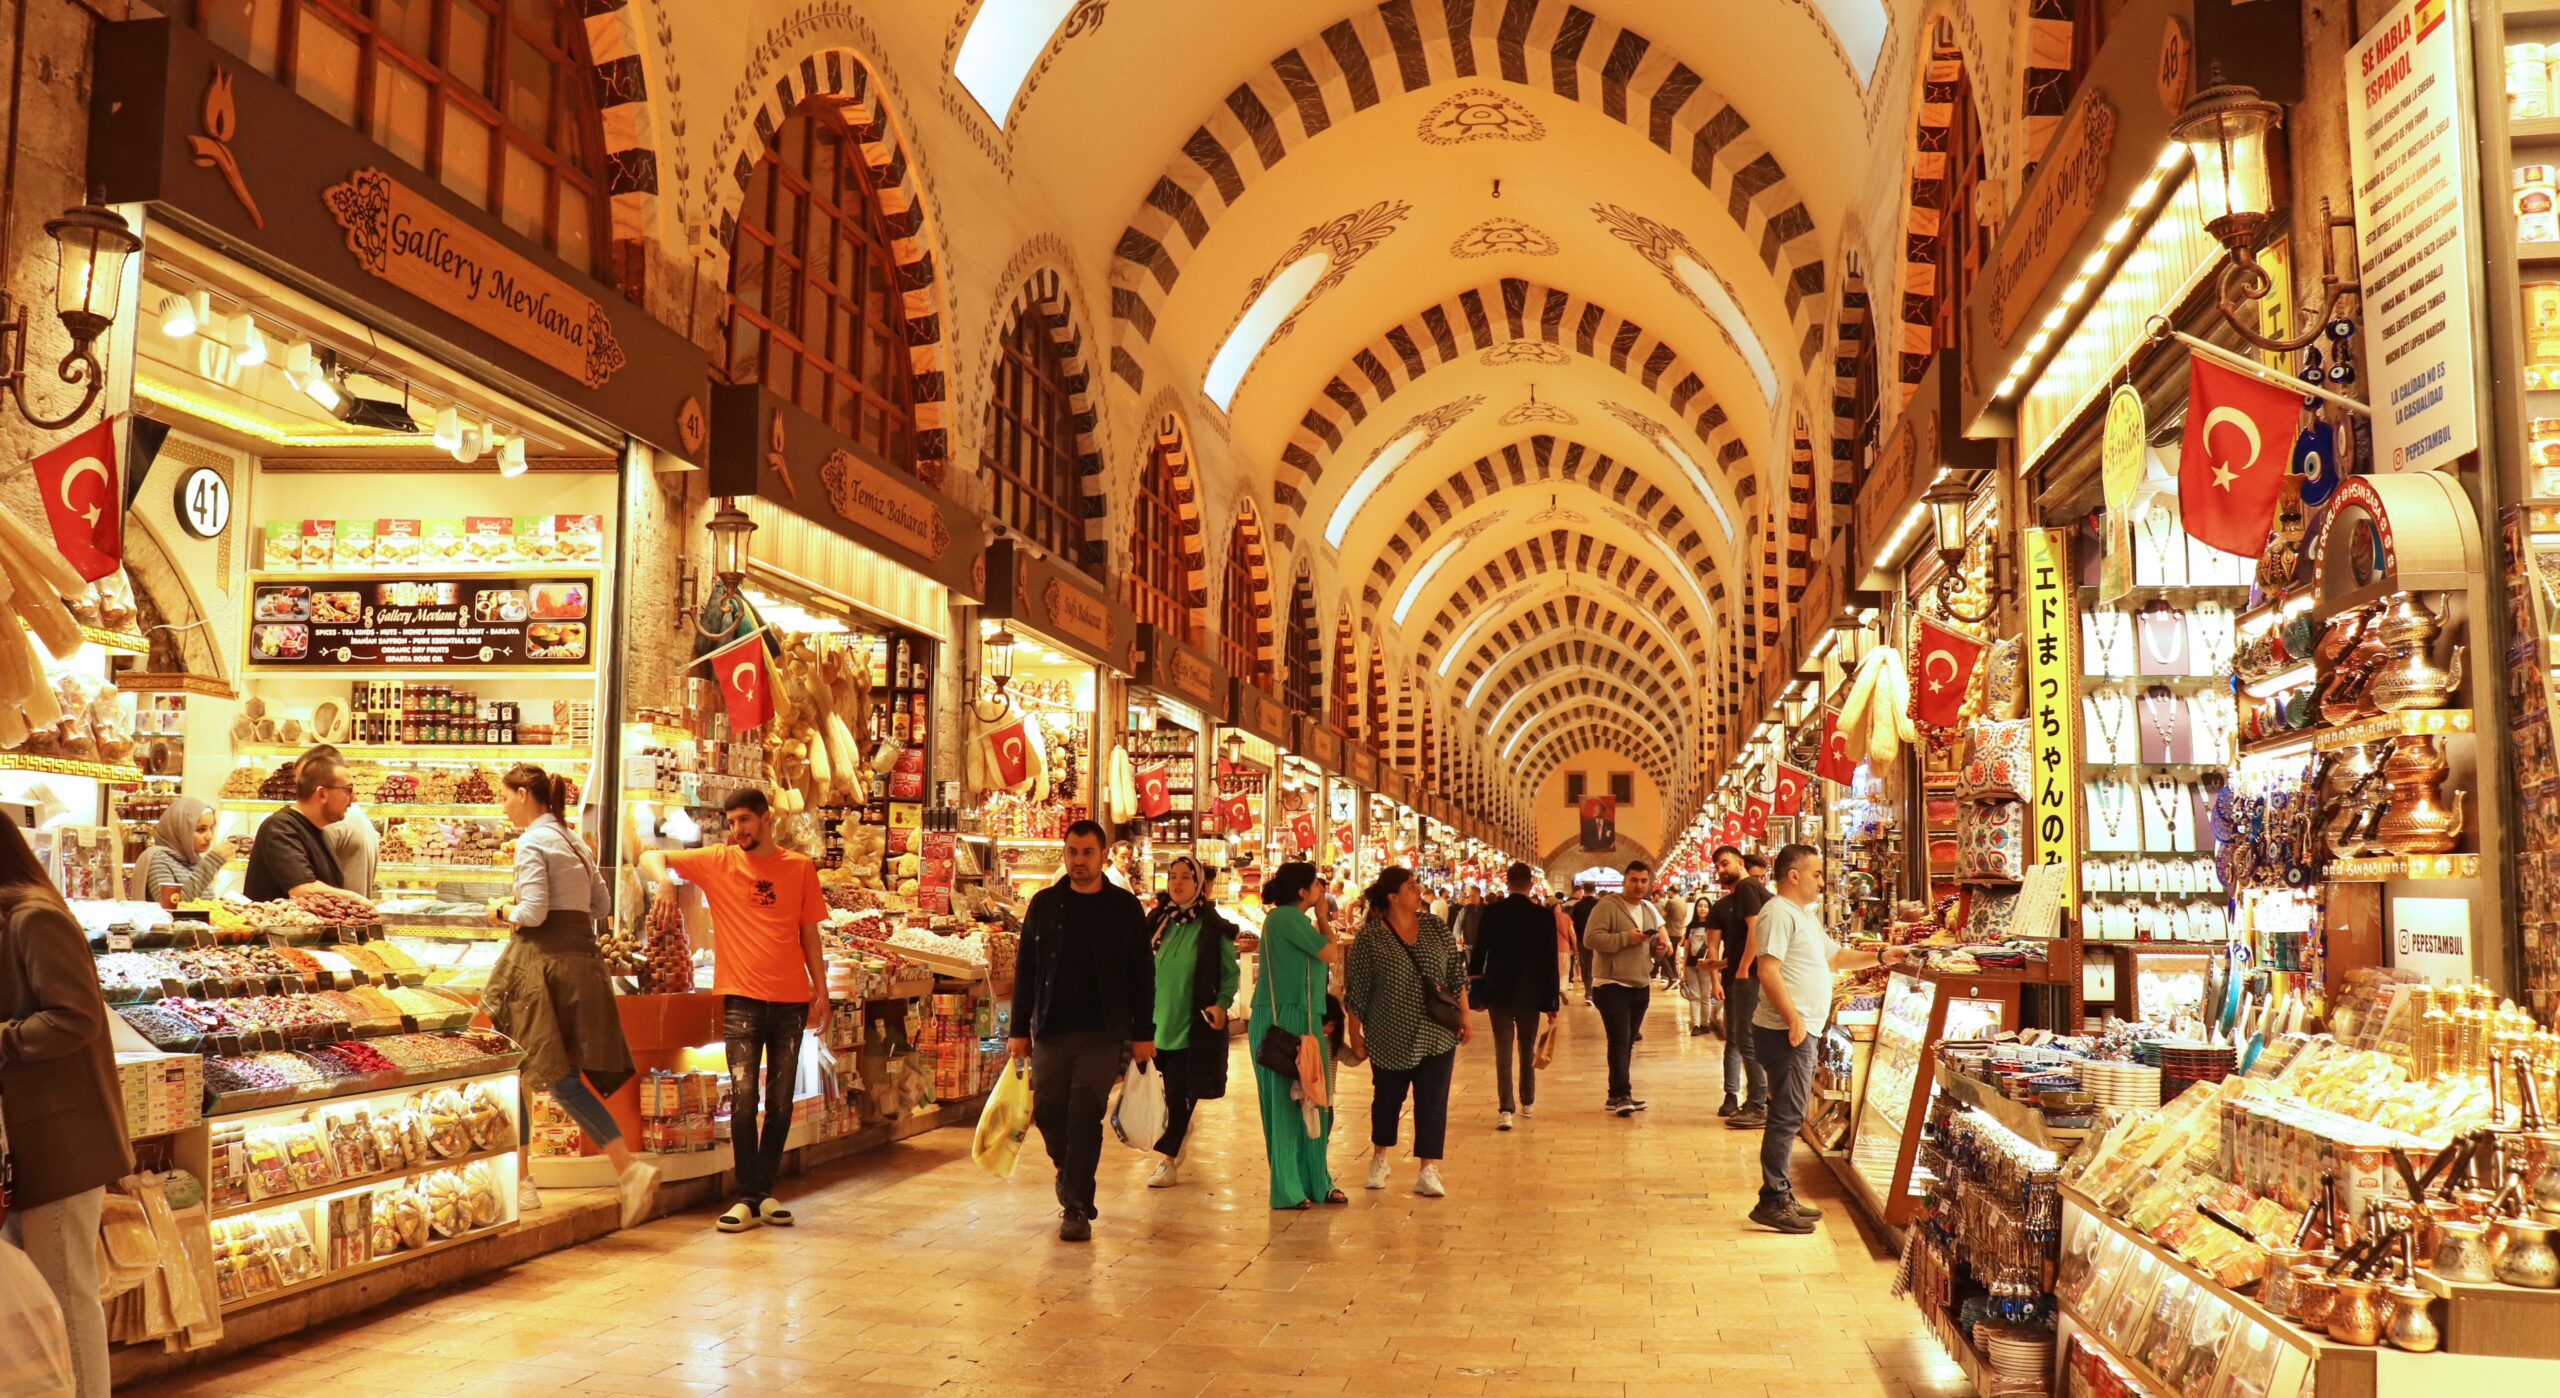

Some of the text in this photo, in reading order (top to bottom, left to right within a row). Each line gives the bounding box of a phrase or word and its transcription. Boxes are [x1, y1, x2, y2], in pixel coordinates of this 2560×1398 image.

[2361, 13, 2412, 77] SE HABLA
[2365, 50, 2412, 111] ESPANOL
[2035, 185, 2055, 257] Gift
[2056, 147, 2083, 216] Shop
[391, 213, 585, 347] Gallery Mevlana
[2391, 388, 2399, 406] LA
[2426, 366, 2436, 385] NO
[2436, 360, 2446, 378] ES
[686, 413, 700, 440] 41
[2395, 408, 2404, 426] LA
[2405, 425, 2452, 463] PEPESTAMBUL
[193, 478, 218, 527] 41
[851, 478, 929, 539] Temiz Baharat
[377, 608, 457, 624] Gallery Mevlana
[2035, 567, 2065, 898] エドまっちゃんのみ
[924, 835, 939, 843] TEA
[2412, 933, 2464, 955] PEPESTAMBUL
